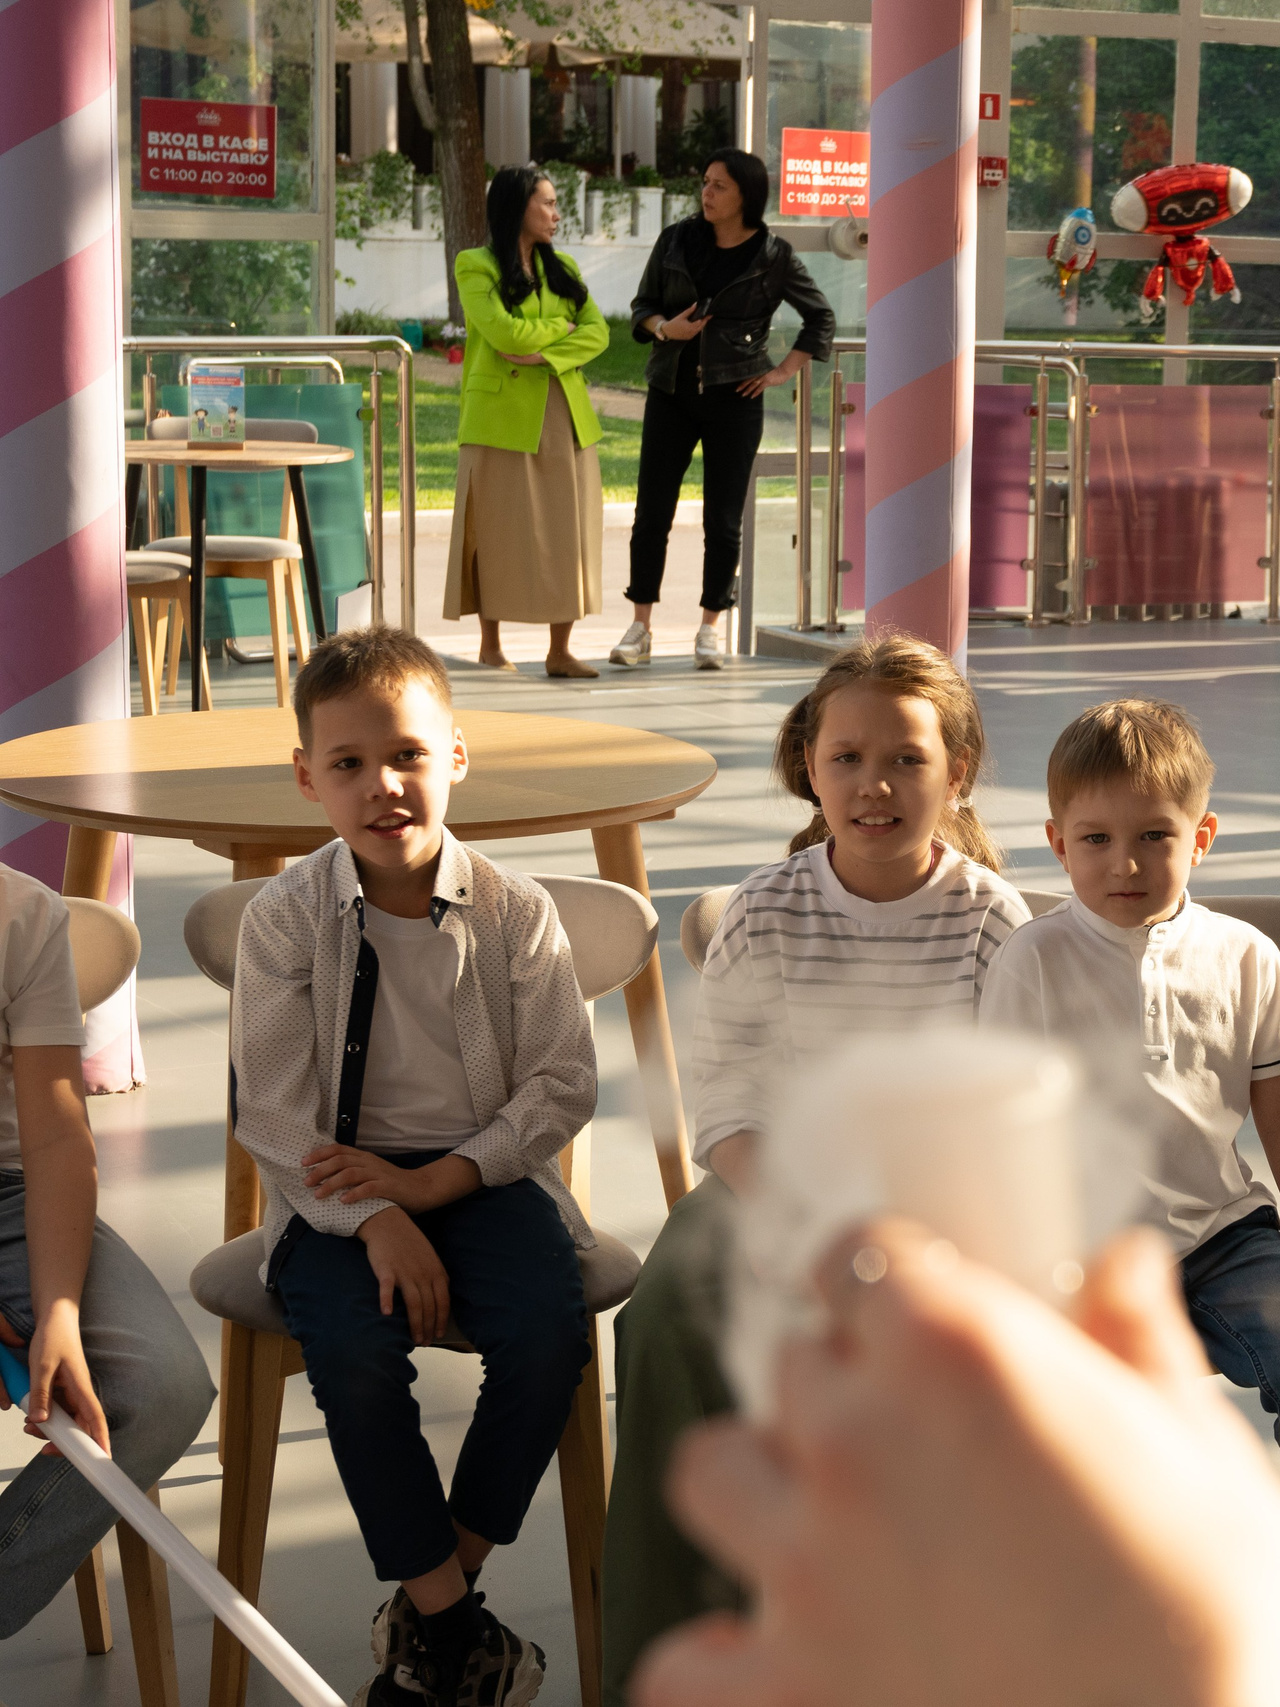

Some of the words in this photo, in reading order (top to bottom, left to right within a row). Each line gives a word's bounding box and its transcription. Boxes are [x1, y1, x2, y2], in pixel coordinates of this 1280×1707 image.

[148, 131, 198, 149] ВХОД
[202, 134, 214, 148] В
[219, 135, 268, 151] КАФЕ
[148, 147, 158, 159] И
[162, 148, 184, 160] НА
[187, 149, 269, 166] ВЫСТАВКУ
[787, 158, 821, 175] ВХОД
[823, 160, 832, 173] В
[833, 161, 868, 175] КАФЕ
[163, 168, 197, 182] 11:00
[200, 170, 223, 184] ДО
[226, 172, 267, 186] 20:00
[786, 173, 795, 184] И
[796, 174, 811, 185] НА
[812, 174, 868, 188] ВЫСТАВКУ
[796, 192, 820, 204] 11:00
[821, 192, 837, 206] ДО
